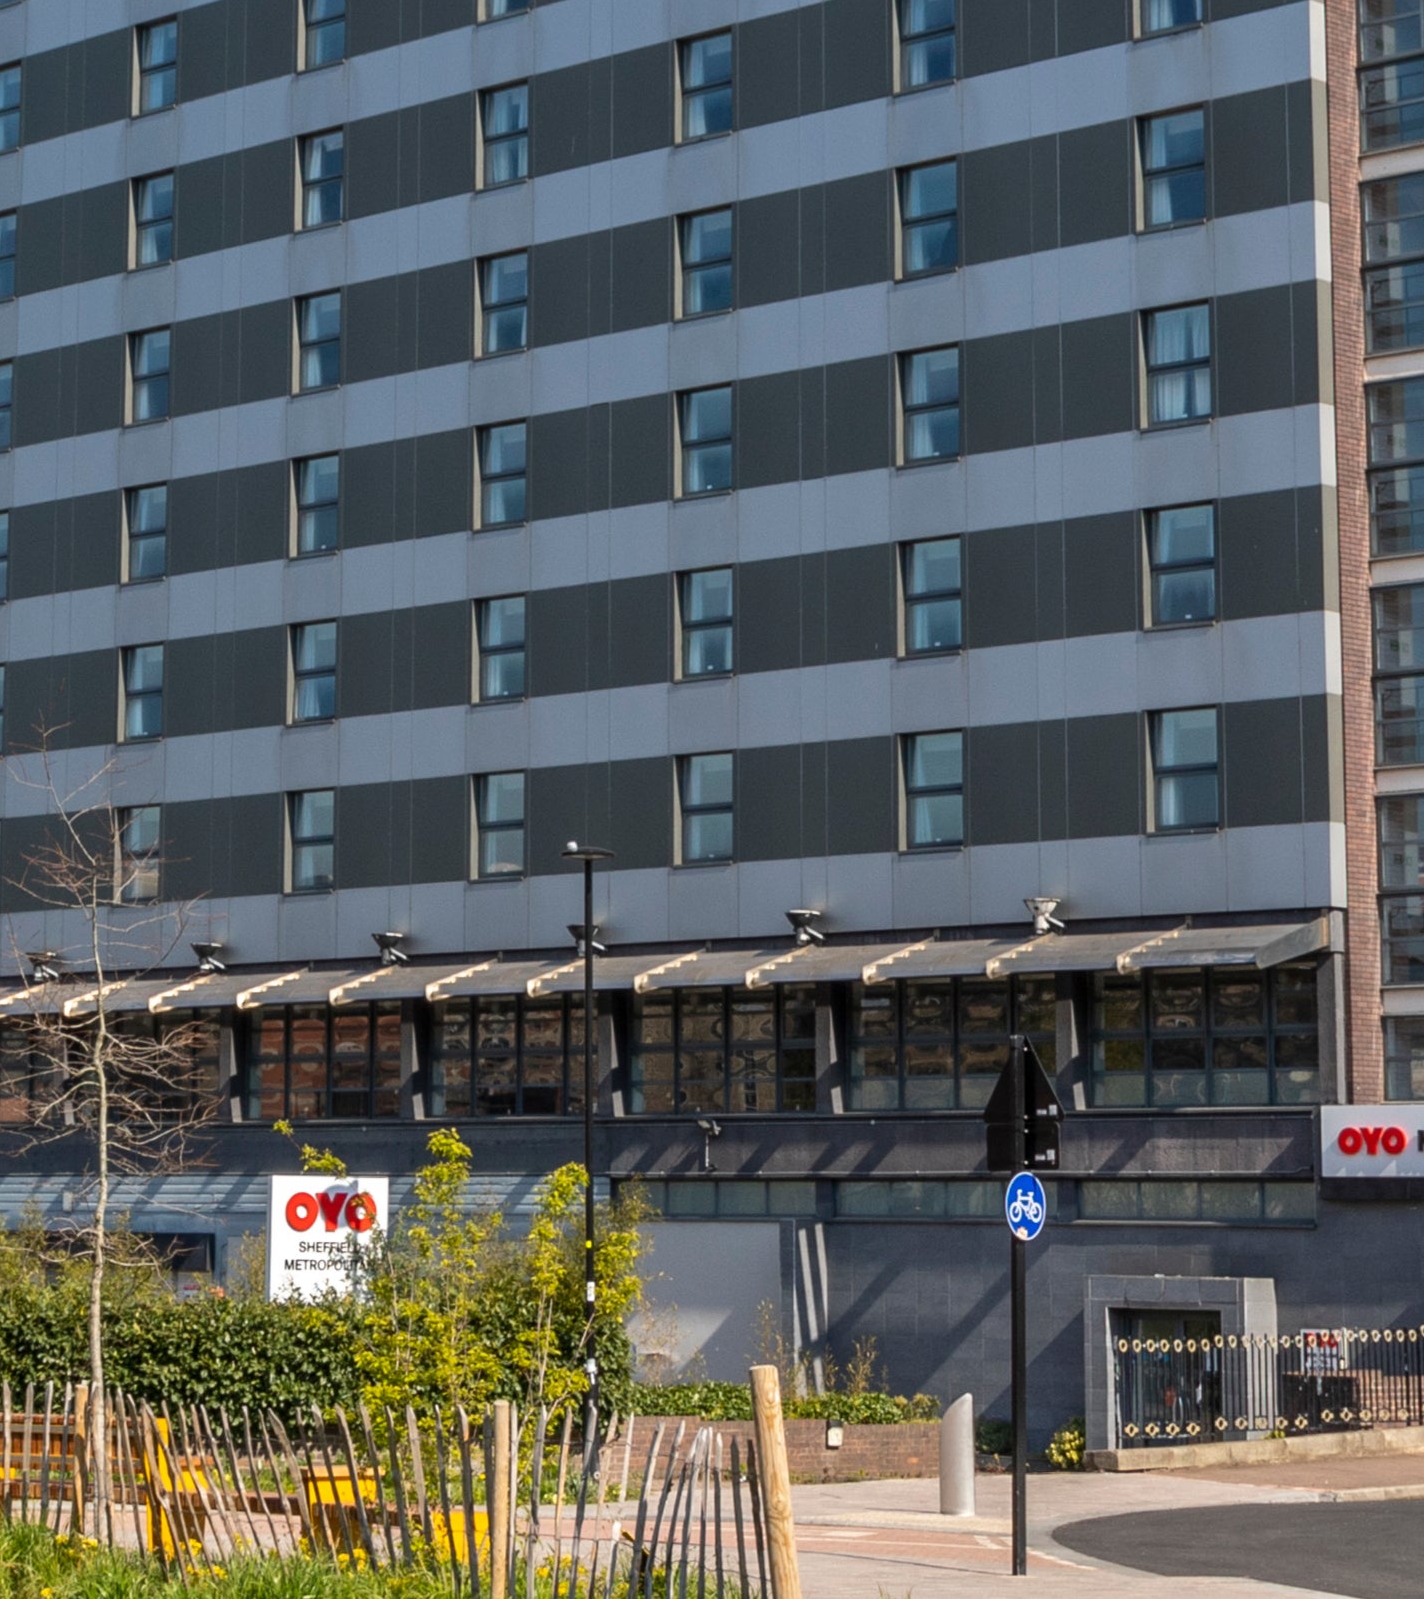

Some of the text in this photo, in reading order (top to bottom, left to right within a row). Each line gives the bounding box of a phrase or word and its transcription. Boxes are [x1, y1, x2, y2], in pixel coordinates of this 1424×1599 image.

[1337, 1126, 1407, 1155] OYO
[285, 1191, 377, 1233] OYO
[298, 1241, 362, 1253] SHEFFIELD
[284, 1259, 375, 1271] METROPOLITA
